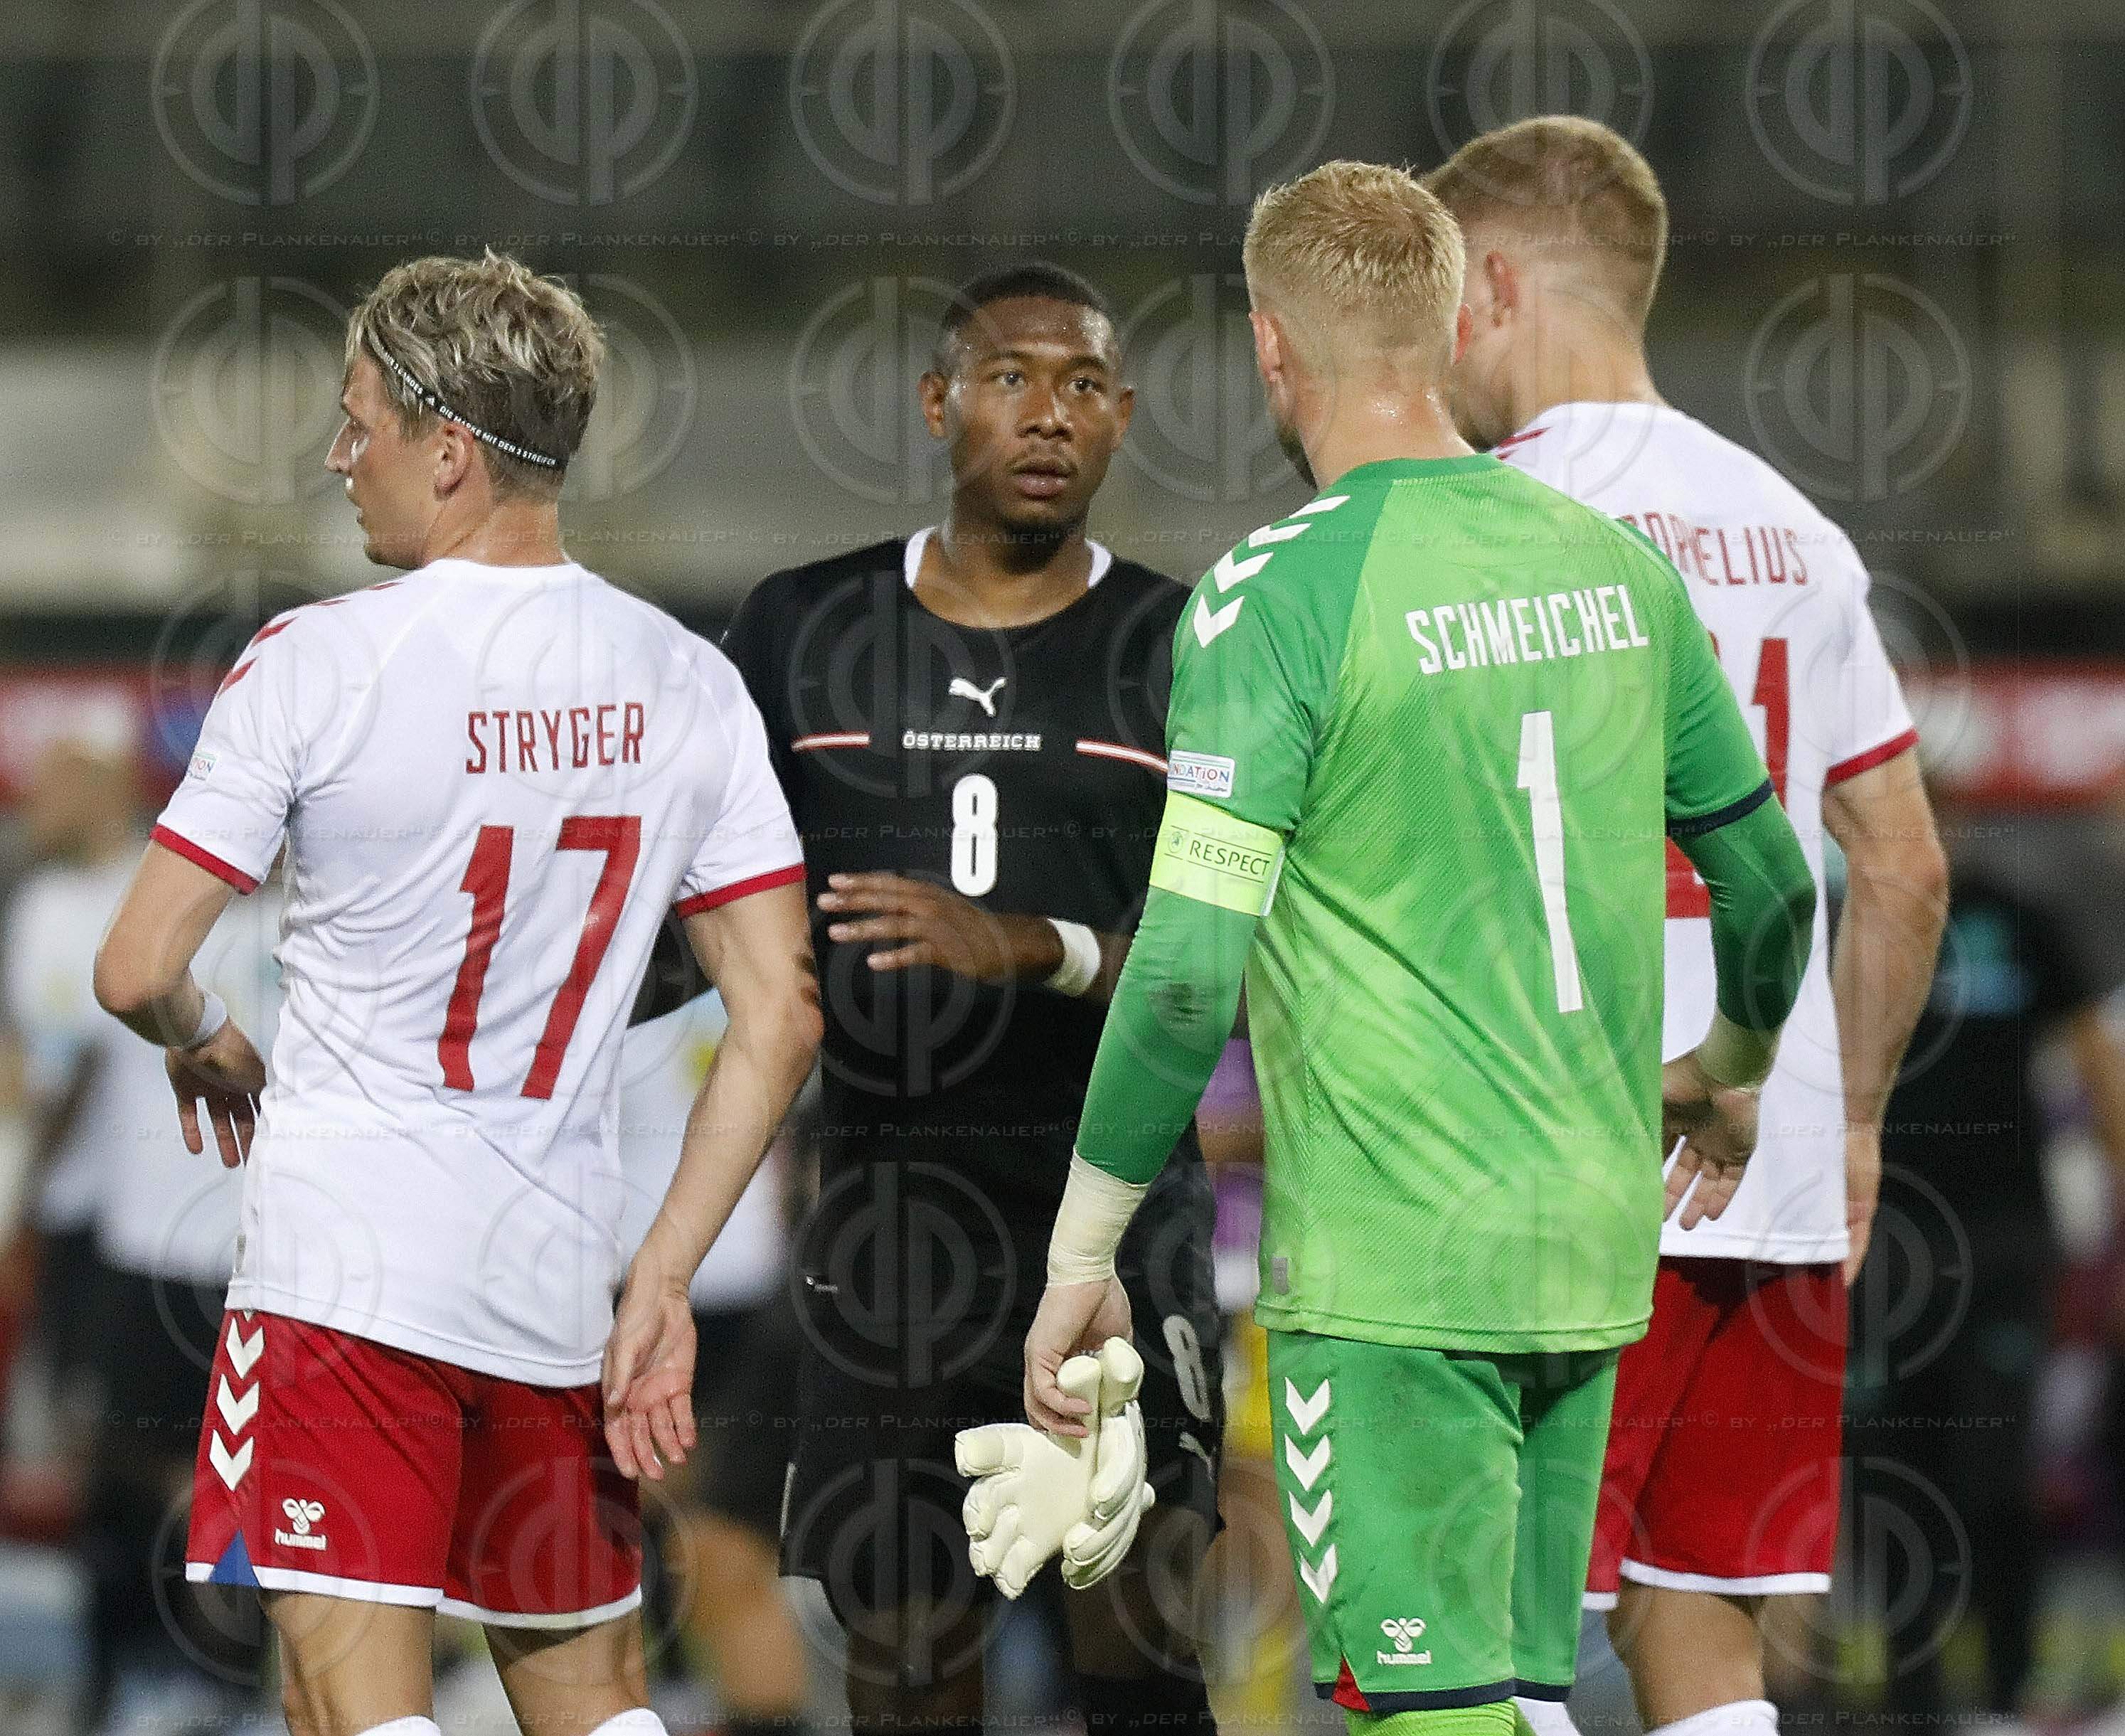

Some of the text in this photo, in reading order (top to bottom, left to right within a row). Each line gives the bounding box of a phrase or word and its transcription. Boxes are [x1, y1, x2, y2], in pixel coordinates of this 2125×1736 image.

[440, 405, 453, 419] DIE
[481, 432, 499, 444] MIT
[498, 440, 516, 453] DEN
[1405, 585, 1651, 675] SCHMEICHEL
[466, 702, 644, 774] STRYGER
[902, 730, 1043, 751] ÖSTERREICH
[951, 773, 998, 898] 8
[1188, 839, 1271, 877] RESPECT
[1516, 710, 1584, 1013] 1
[437, 815, 641, 1100] 17
[1162, 1314, 1212, 1421] 8
